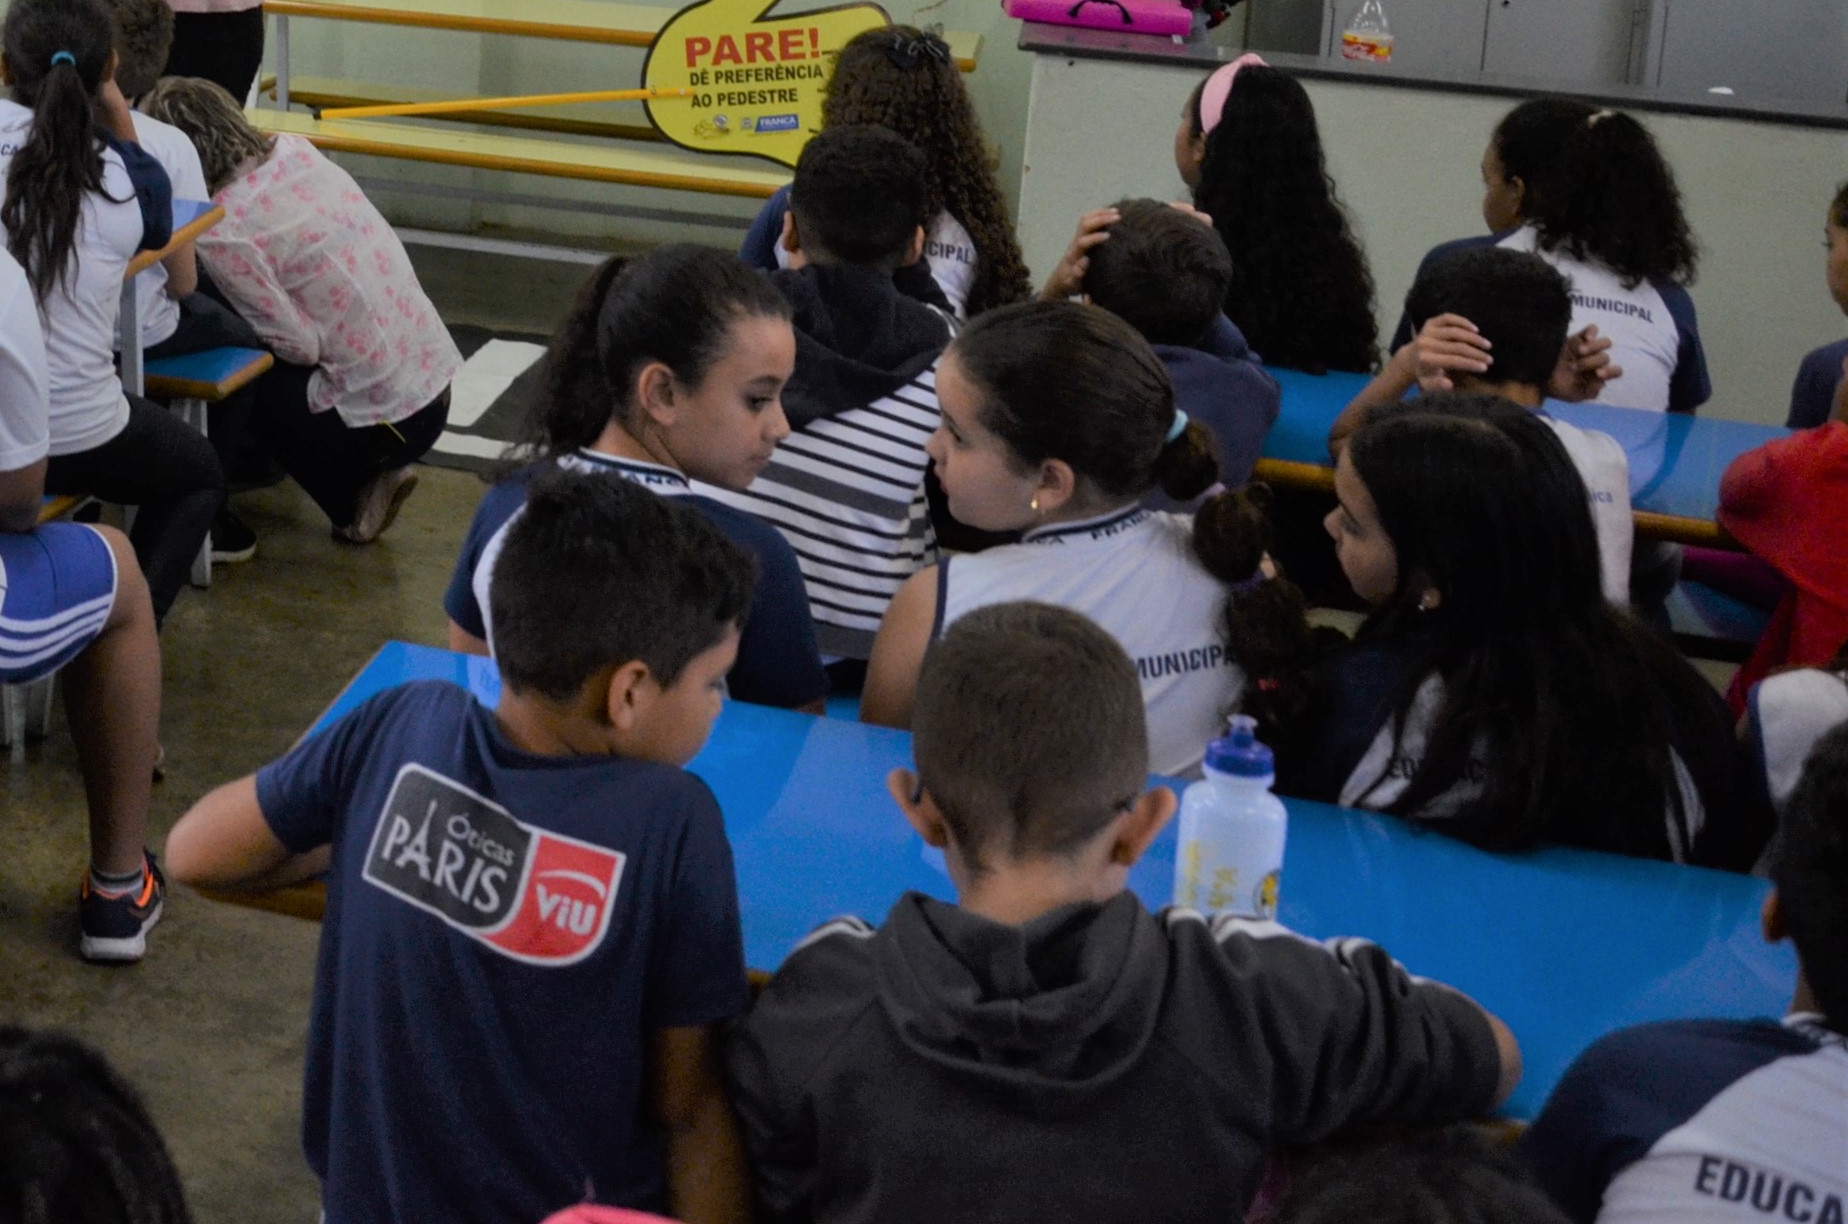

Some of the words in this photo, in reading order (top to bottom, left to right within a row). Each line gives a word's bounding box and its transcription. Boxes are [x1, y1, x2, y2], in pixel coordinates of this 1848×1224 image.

[685, 27, 821, 68] PARE!
[690, 68, 710, 86] DÊ
[714, 63, 824, 85] PREFERÊNCIA
[691, 93, 712, 109] AO
[717, 88, 798, 107] PEDESTRE
[928, 240, 972, 265] CIPAL
[1571, 294, 1654, 323] MUNICIPAL
[1137, 644, 1236, 680] MUNICIPA
[381, 799, 508, 914] PARIS
[446, 812, 516, 868] Óticas
[1694, 1153, 1844, 1224] EDUCA
